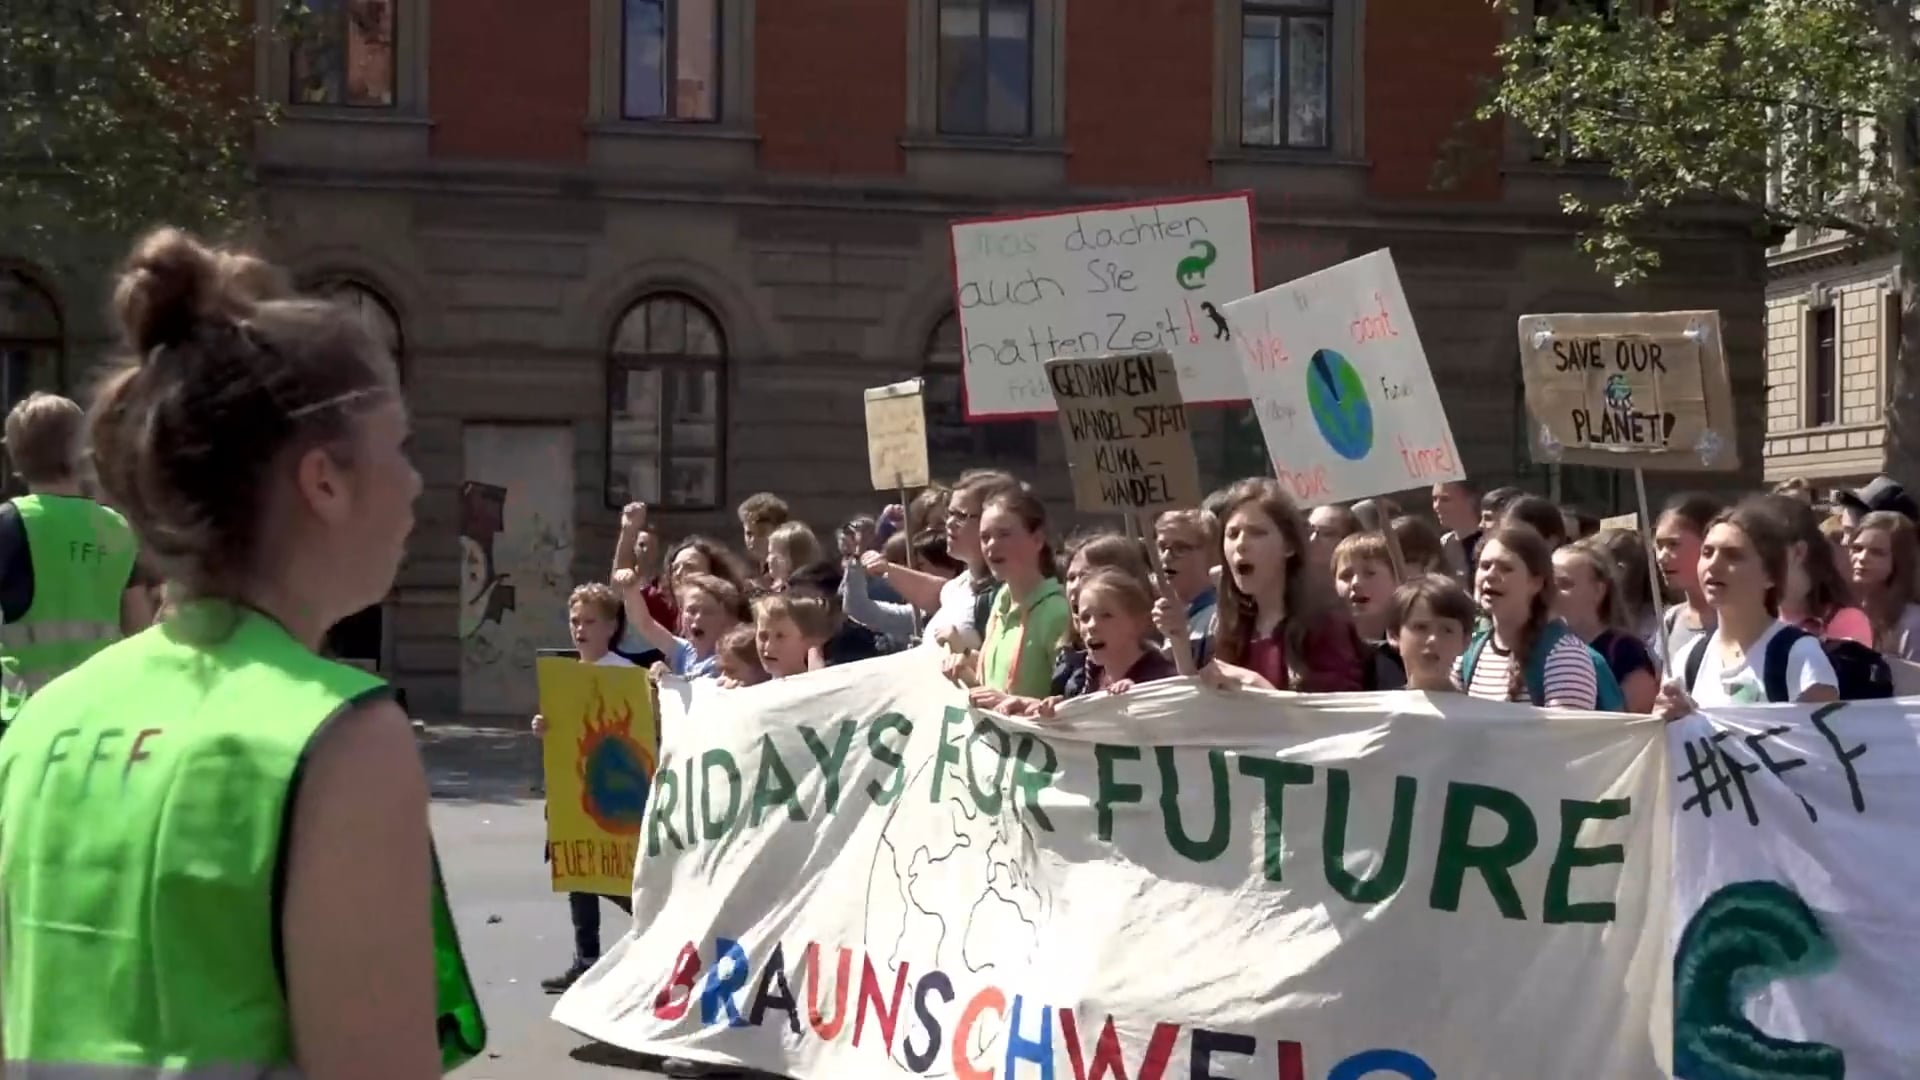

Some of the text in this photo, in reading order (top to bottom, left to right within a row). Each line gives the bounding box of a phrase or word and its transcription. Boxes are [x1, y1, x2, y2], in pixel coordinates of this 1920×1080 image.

[1065, 208, 1208, 252] dachten
[958, 258, 1137, 308] auch Sie
[1553, 340, 1667, 373] SAVE OUR
[1067, 403, 1187, 442] WANDEL STATT
[1572, 409, 1676, 446] PLANET!
[1101, 473, 1176, 507] WANDEL
[68, 541, 107, 563] FFF
[36, 728, 163, 798] FFF
[648, 705, 1632, 924] RIDAYS FOR FUTURE
[552, 839, 595, 878] EUER
